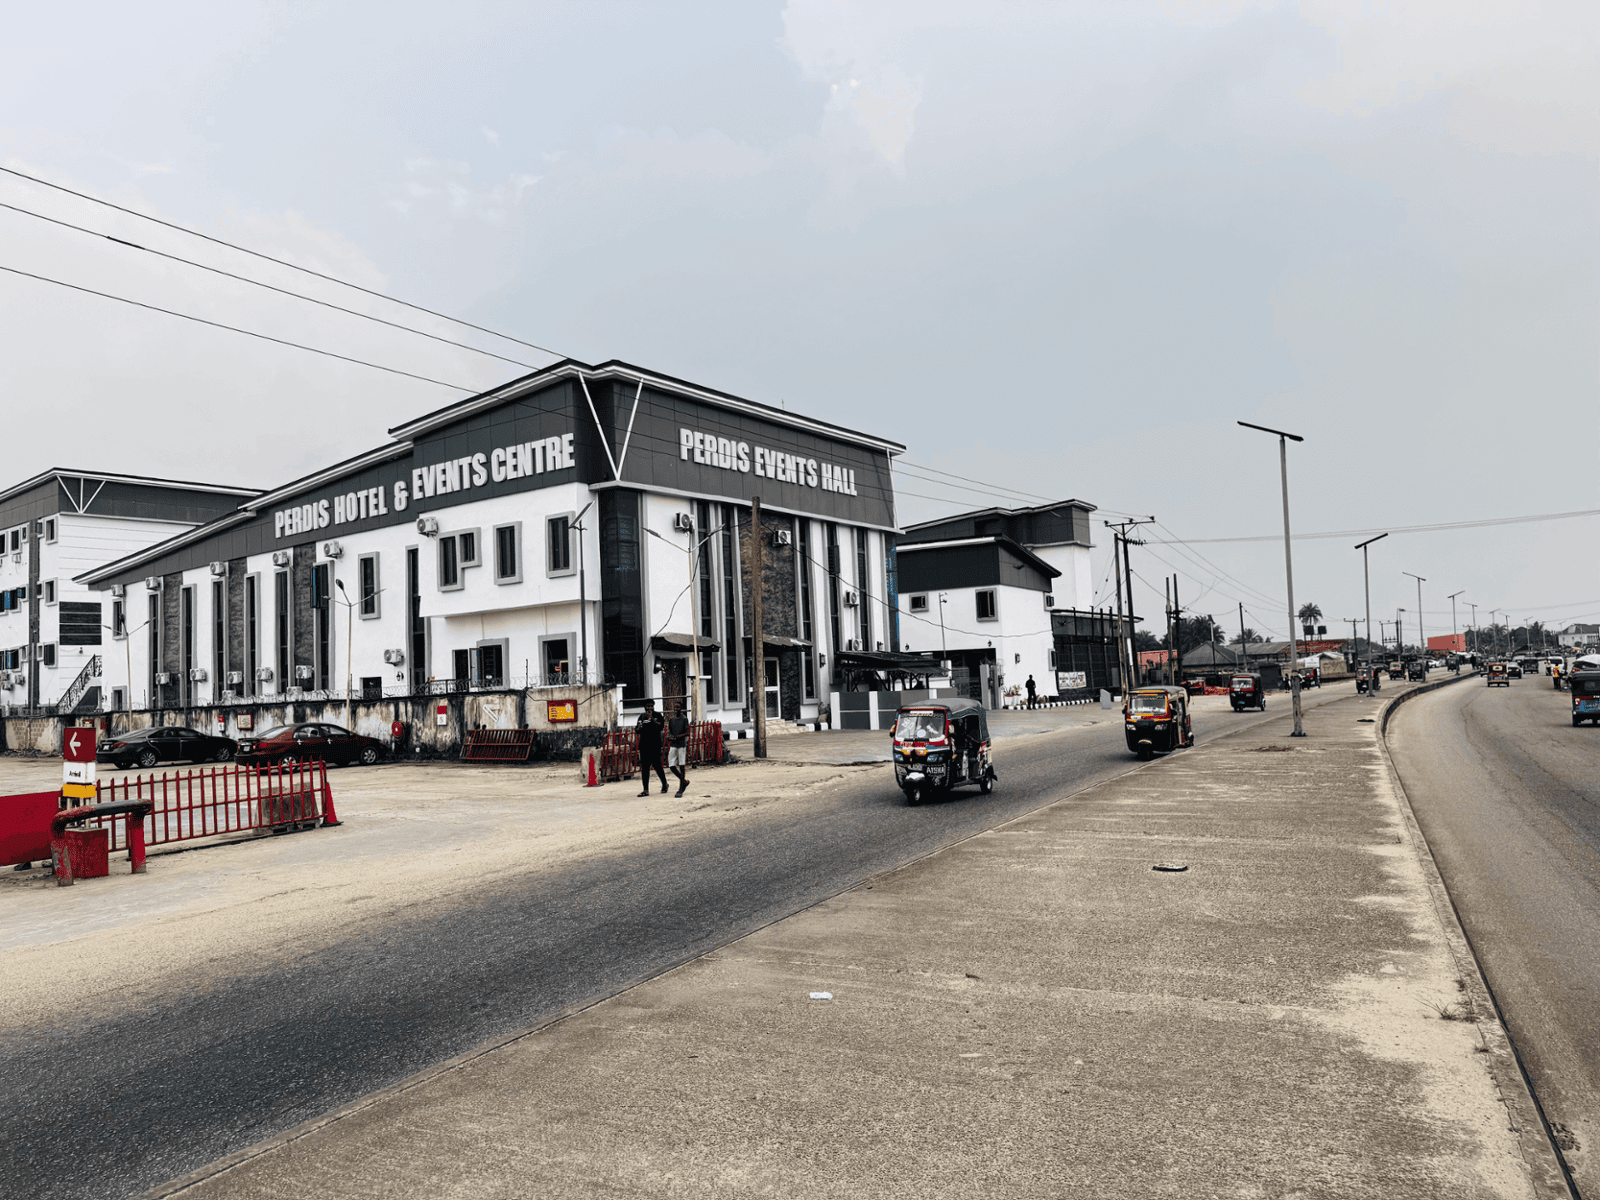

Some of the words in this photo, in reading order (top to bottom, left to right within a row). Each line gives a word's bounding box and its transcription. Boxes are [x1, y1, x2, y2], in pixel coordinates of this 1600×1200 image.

[275, 499, 331, 539] PERDIS
[334, 485, 389, 525] HOTEL
[393, 480, 409, 512] &
[412, 452, 488, 501] EVENTS
[491, 433, 576, 483] CENTRE
[679, 428, 750, 473] PERDIS
[754, 446, 818, 488] EVENTS
[821, 463, 858, 497] HALL
